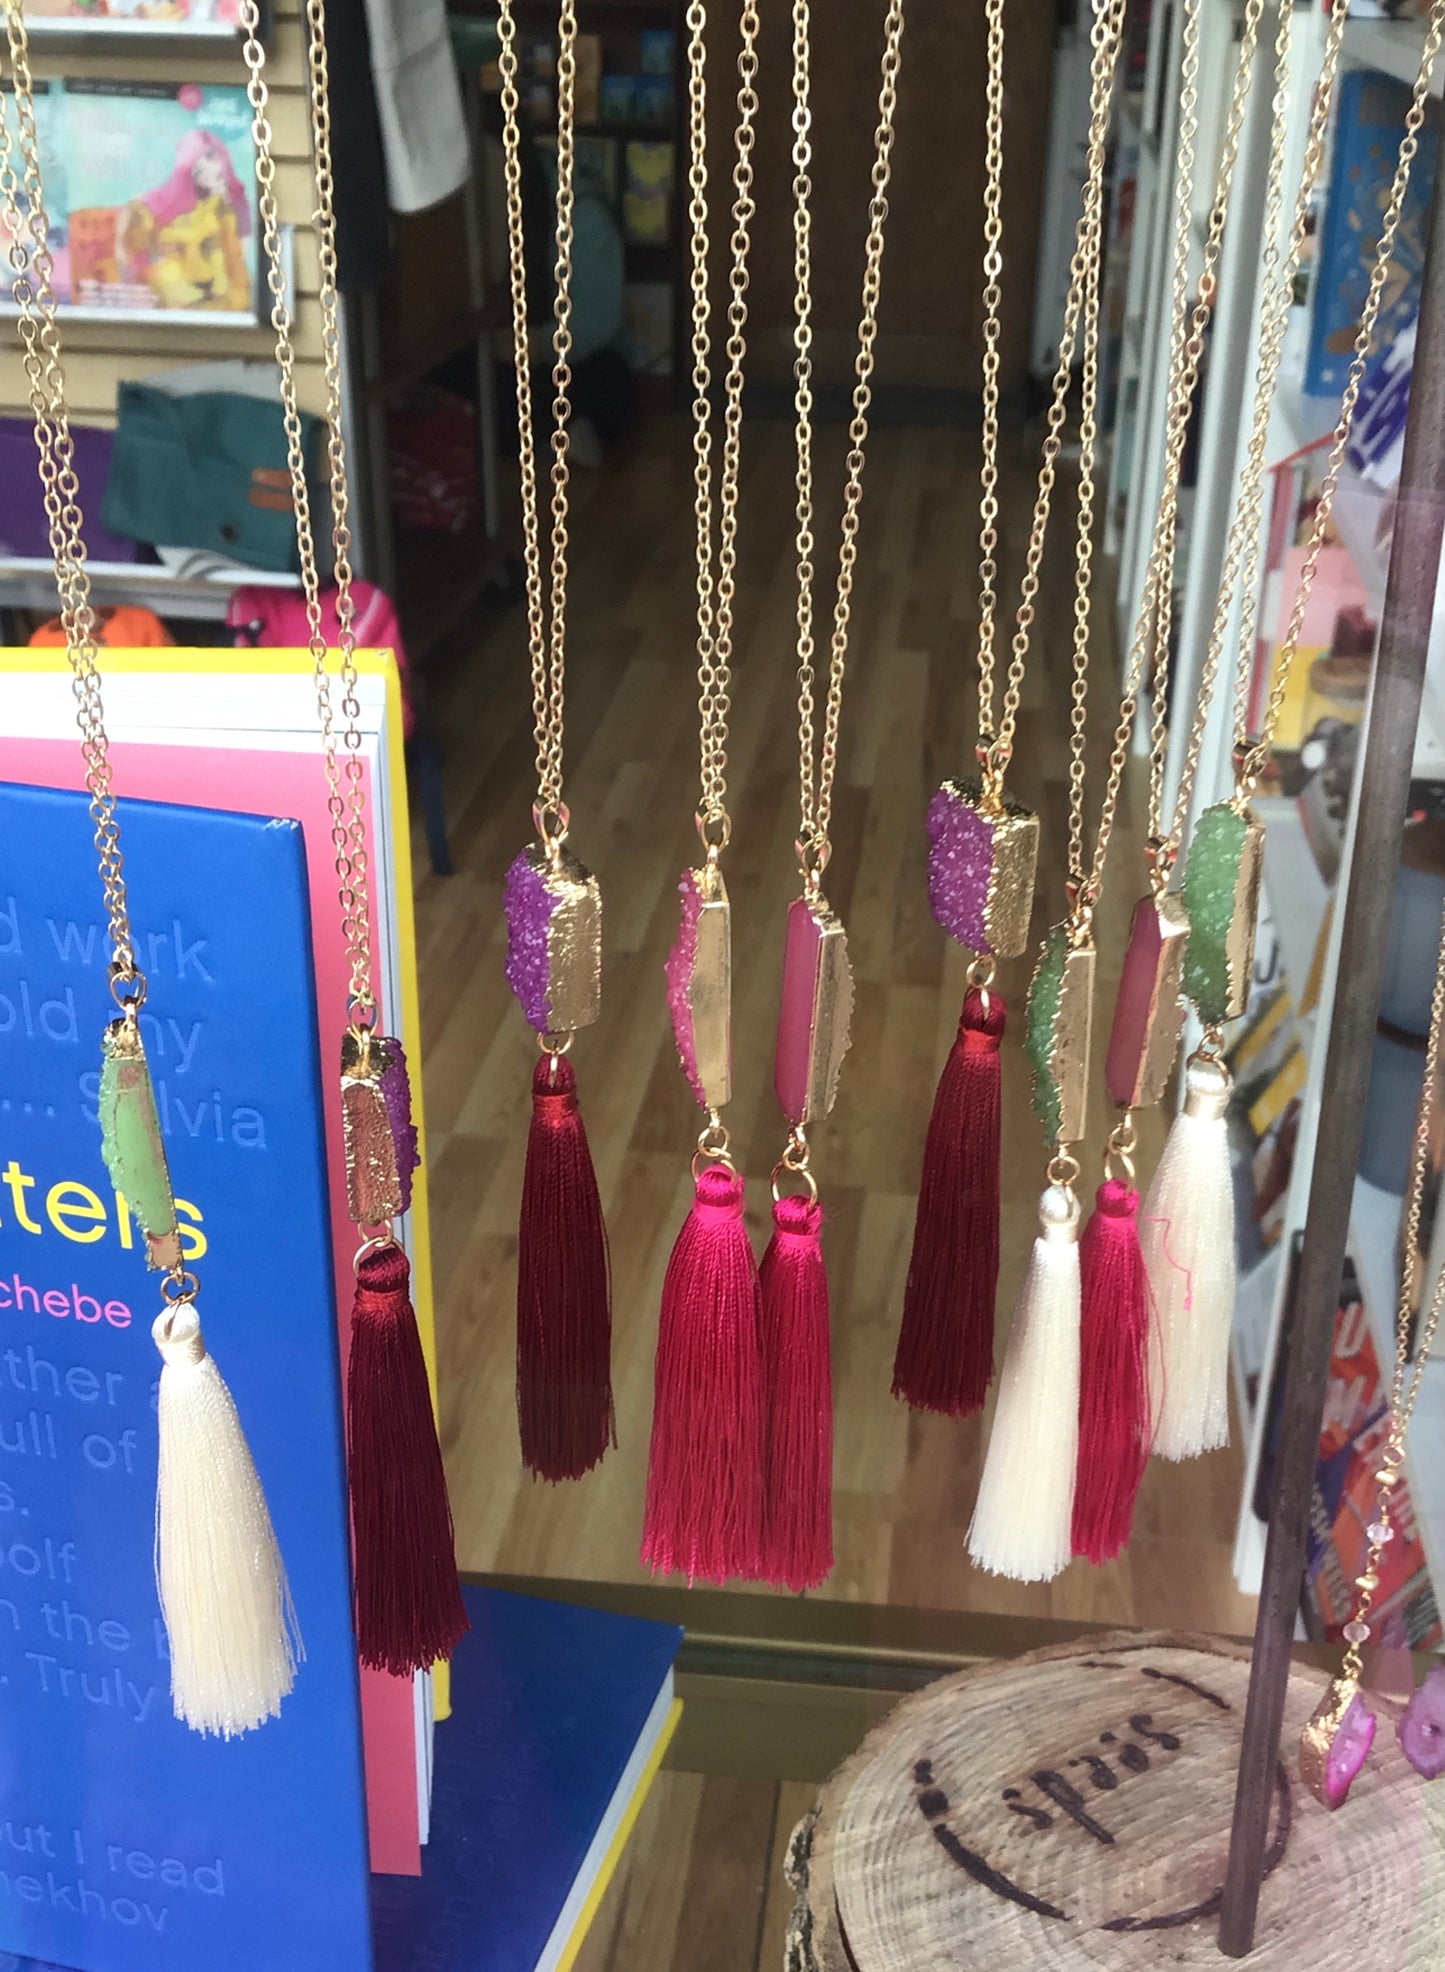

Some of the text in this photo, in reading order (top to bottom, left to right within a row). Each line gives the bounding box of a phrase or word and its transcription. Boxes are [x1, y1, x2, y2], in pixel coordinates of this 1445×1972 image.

[46, 919, 214, 983] work
[79, 1071, 267, 1149] Slvia
[0, 1161, 208, 1261] ters
[2, 1345, 123, 1406] ther
[82, 1429, 137, 1473] of
[0, 1537, 76, 1583] olf
[40, 1600, 131, 1651] the
[25, 1652, 158, 1722] Truly
[73, 1829, 84, 1865] I
[106, 1844, 225, 1897] read
